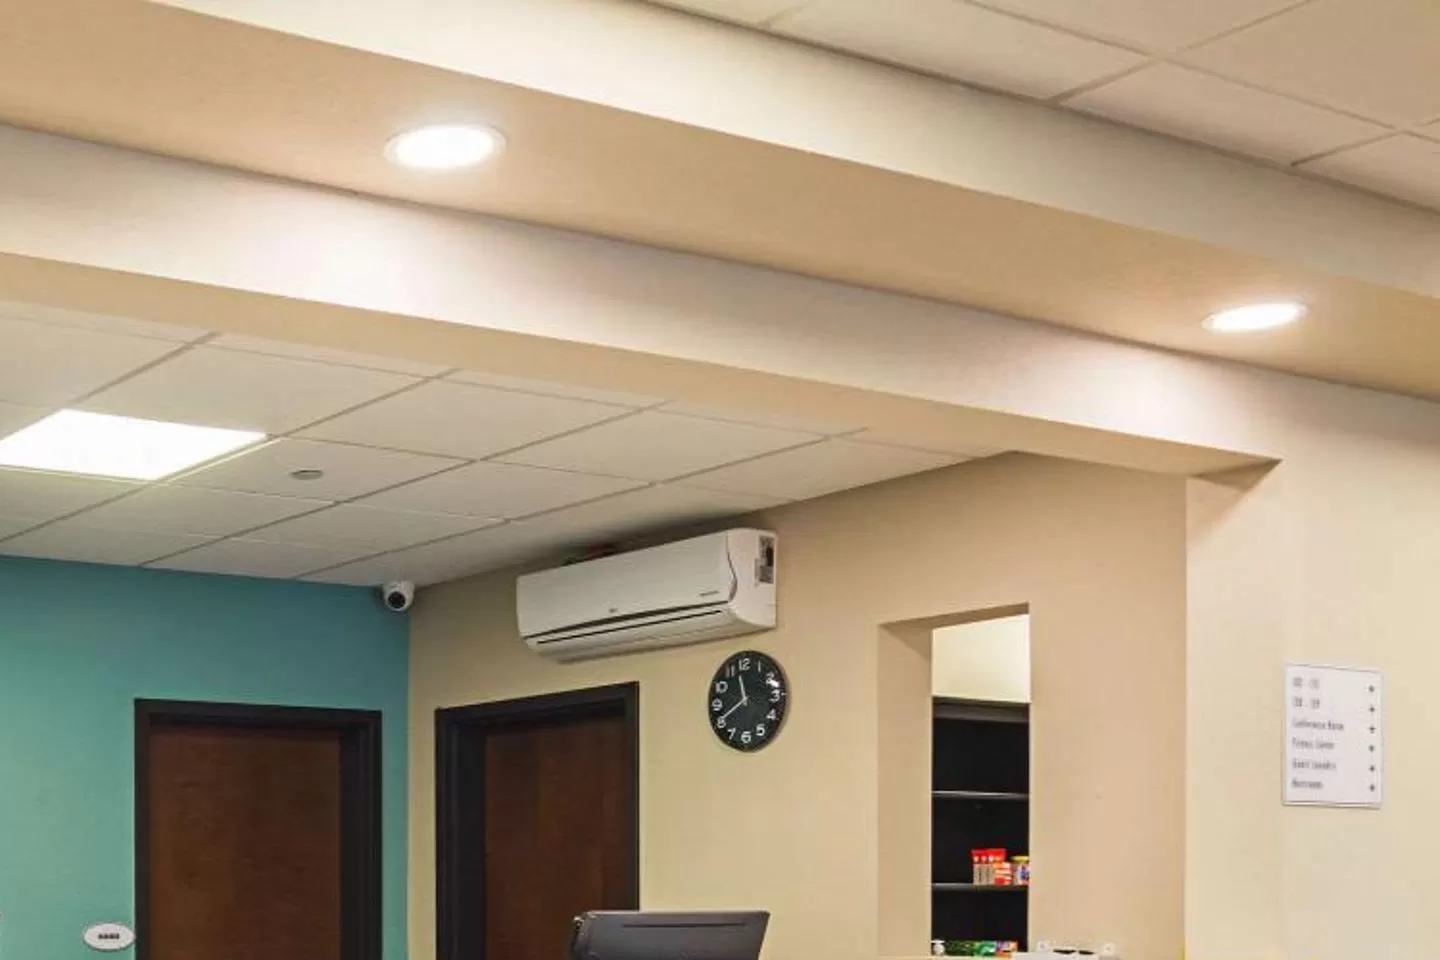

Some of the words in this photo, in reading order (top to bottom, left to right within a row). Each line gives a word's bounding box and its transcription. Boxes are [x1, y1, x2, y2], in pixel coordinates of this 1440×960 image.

[725, 664, 736, 679] 11
[738, 658, 751, 671] 12
[715, 680, 729, 694] 10
[769, 688, 780, 703] 3
[711, 698, 723, 712] 9
[766, 708, 776, 720] 4
[716, 716, 727, 729] 8
[755, 723, 766, 736] 5
[727, 727, 737, 741] 7
[740, 730, 752, 744] 6
